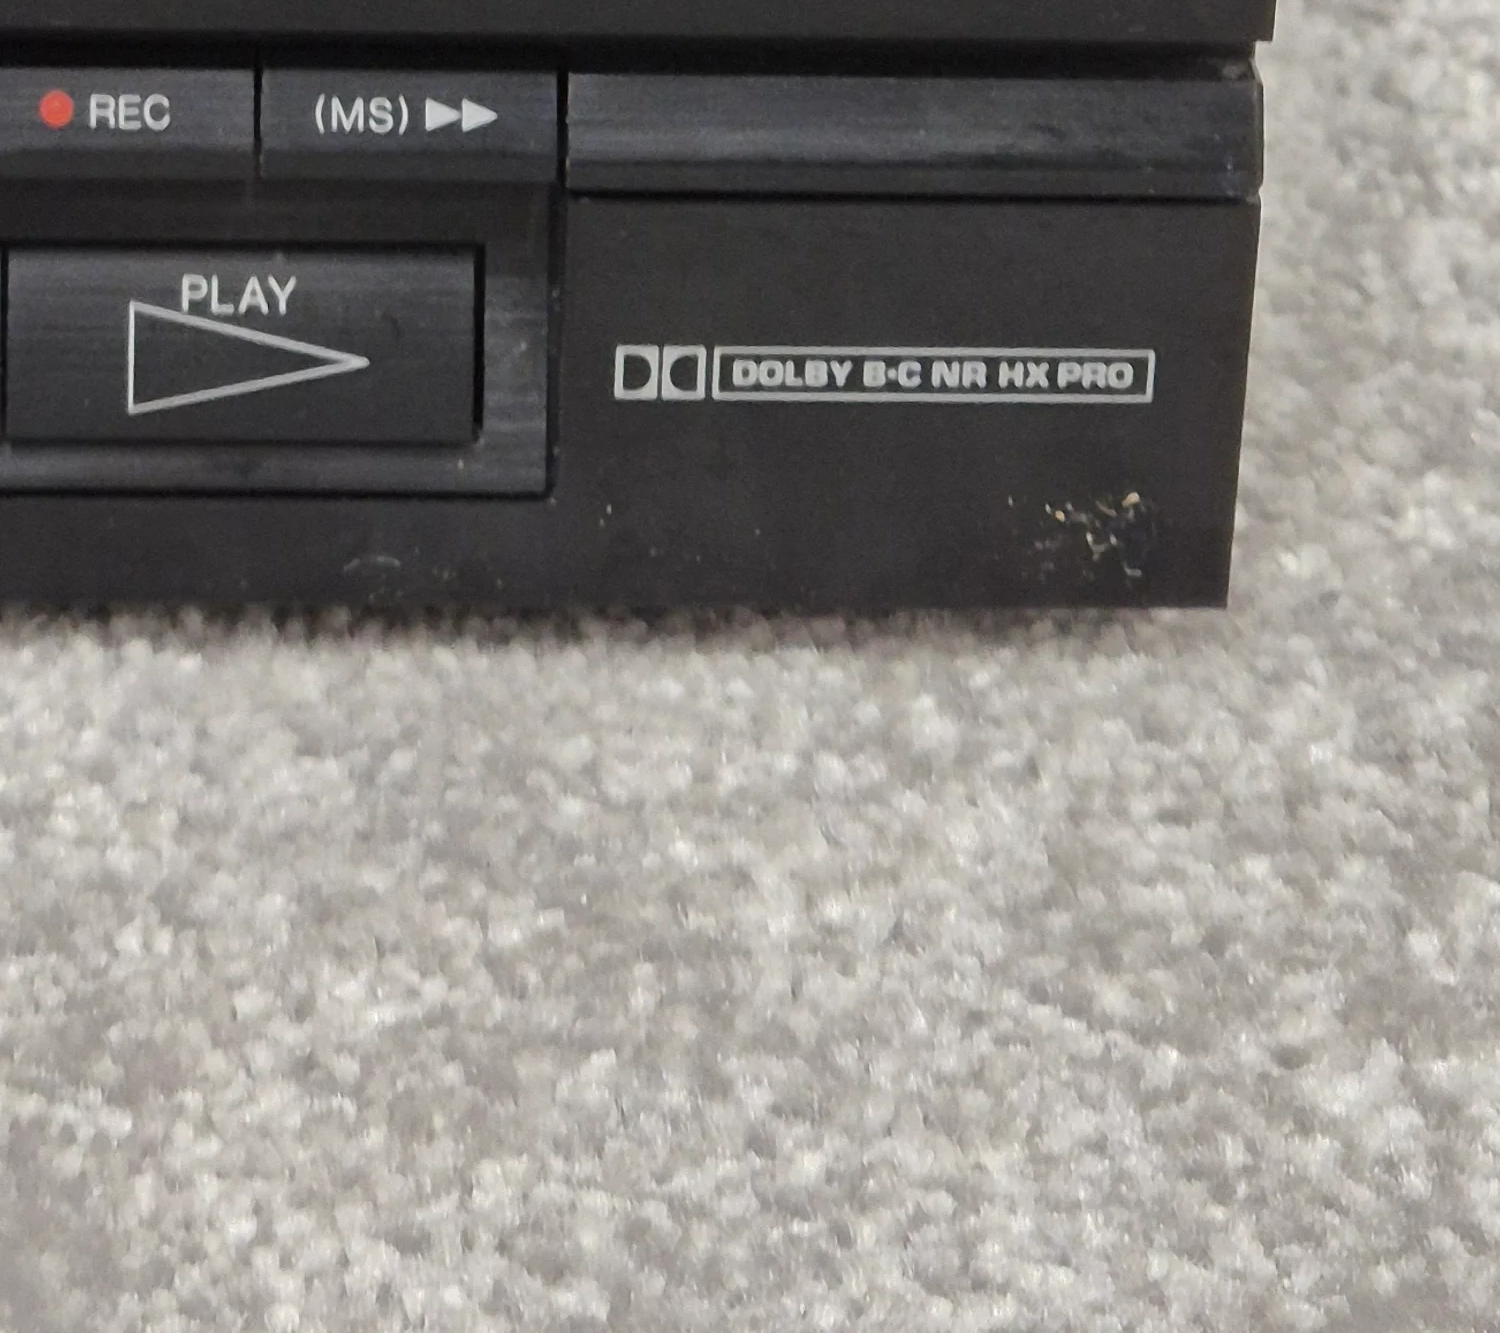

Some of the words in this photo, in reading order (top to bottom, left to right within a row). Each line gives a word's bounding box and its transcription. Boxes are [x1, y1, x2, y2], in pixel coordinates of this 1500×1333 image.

[88, 95, 171, 131] REC
[314, 94, 410, 135] (MS)
[180, 275, 298, 316] PLAY
[732, 359, 854, 389] DOLBY
[931, 361, 987, 389] NR
[998, 362, 1050, 390] HX
[1056, 363, 1134, 391] PRO
